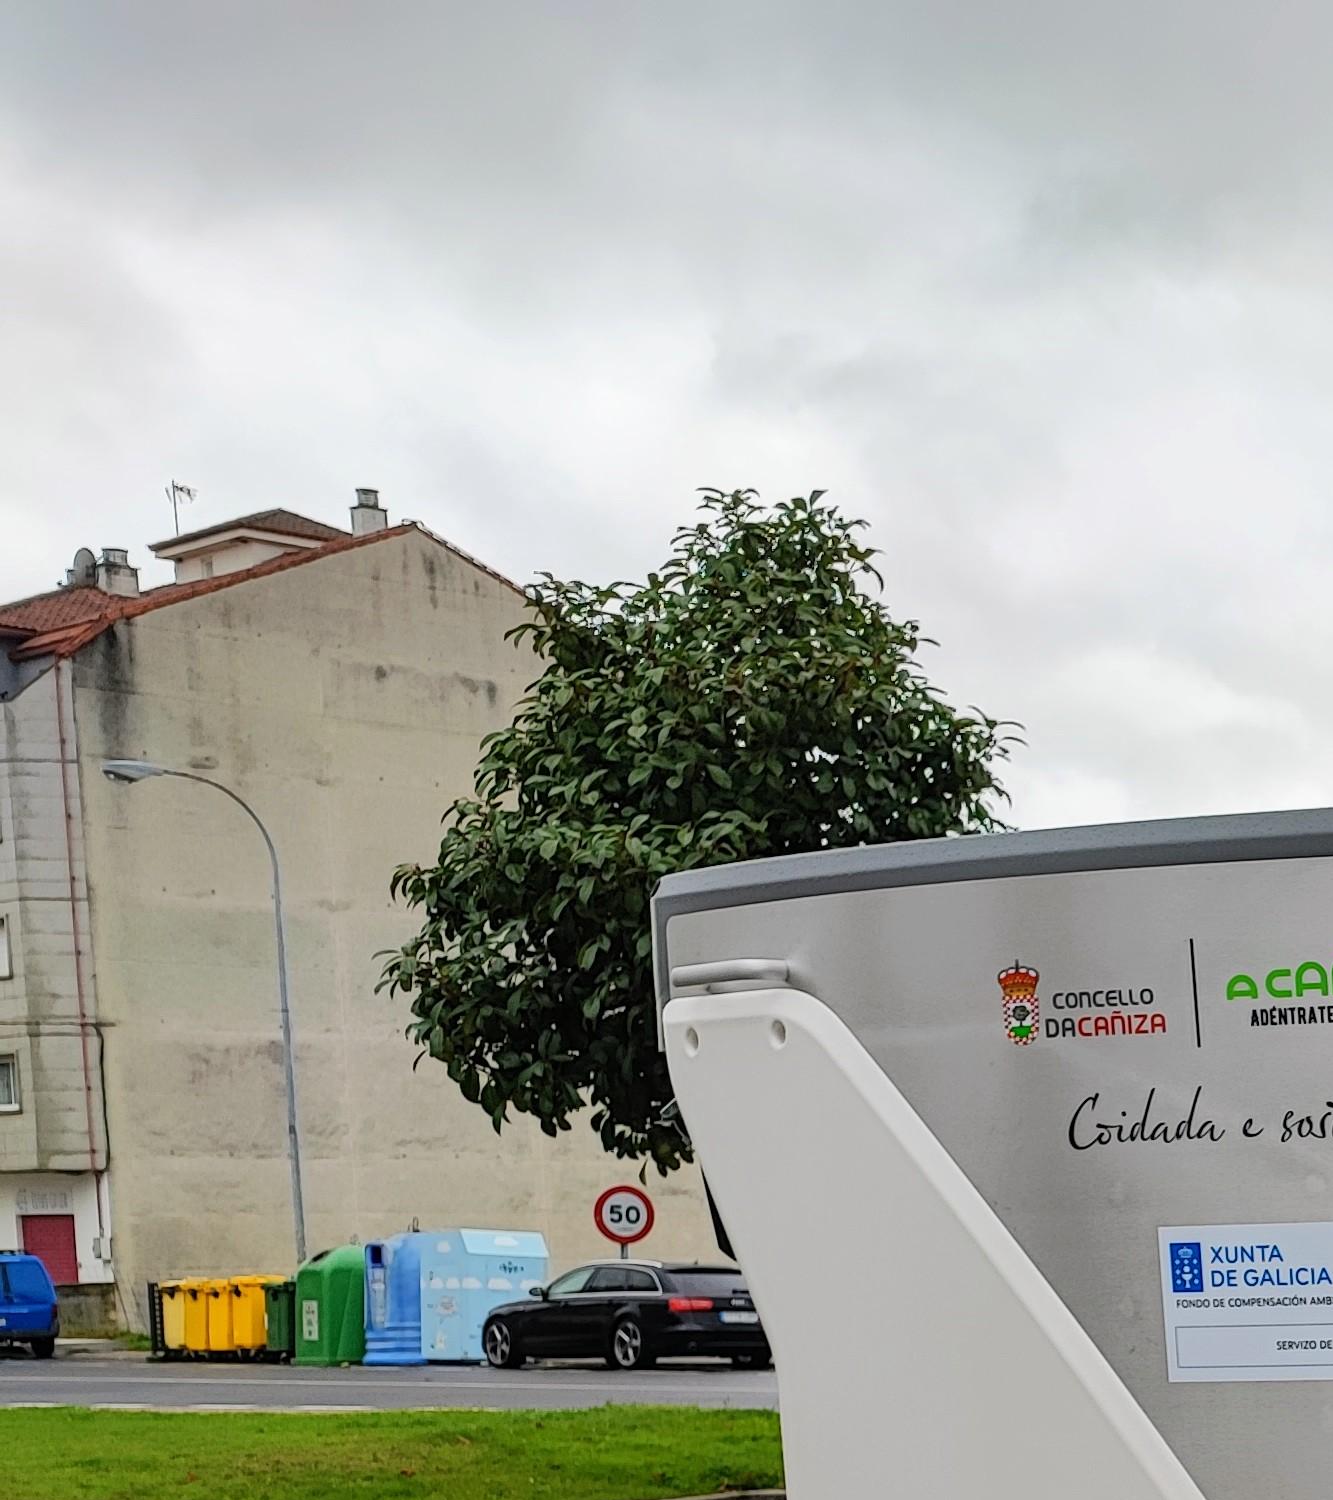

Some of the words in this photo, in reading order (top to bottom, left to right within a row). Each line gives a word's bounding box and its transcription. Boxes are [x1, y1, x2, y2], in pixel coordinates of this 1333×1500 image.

[1052, 988, 1154, 1009] CONCELLO
[1068, 1085, 1226, 1151] Coidada
[1242, 1118, 1264, 1138] e
[609, 1204, 641, 1225] 50
[1210, 1244, 1284, 1264] XUNTA
[1210, 1269, 1238, 1288] DE
[1243, 1267, 1333, 1287] GALICIA
[1176, 1298, 1211, 1309] FONDO
[1212, 1298, 1225, 1308] DE
[1227, 1294, 1307, 1308] COMPENSACIÓN
[1276, 1339, 1317, 1350] SERVIZO
[1319, 1339, 1333, 1350] DE
